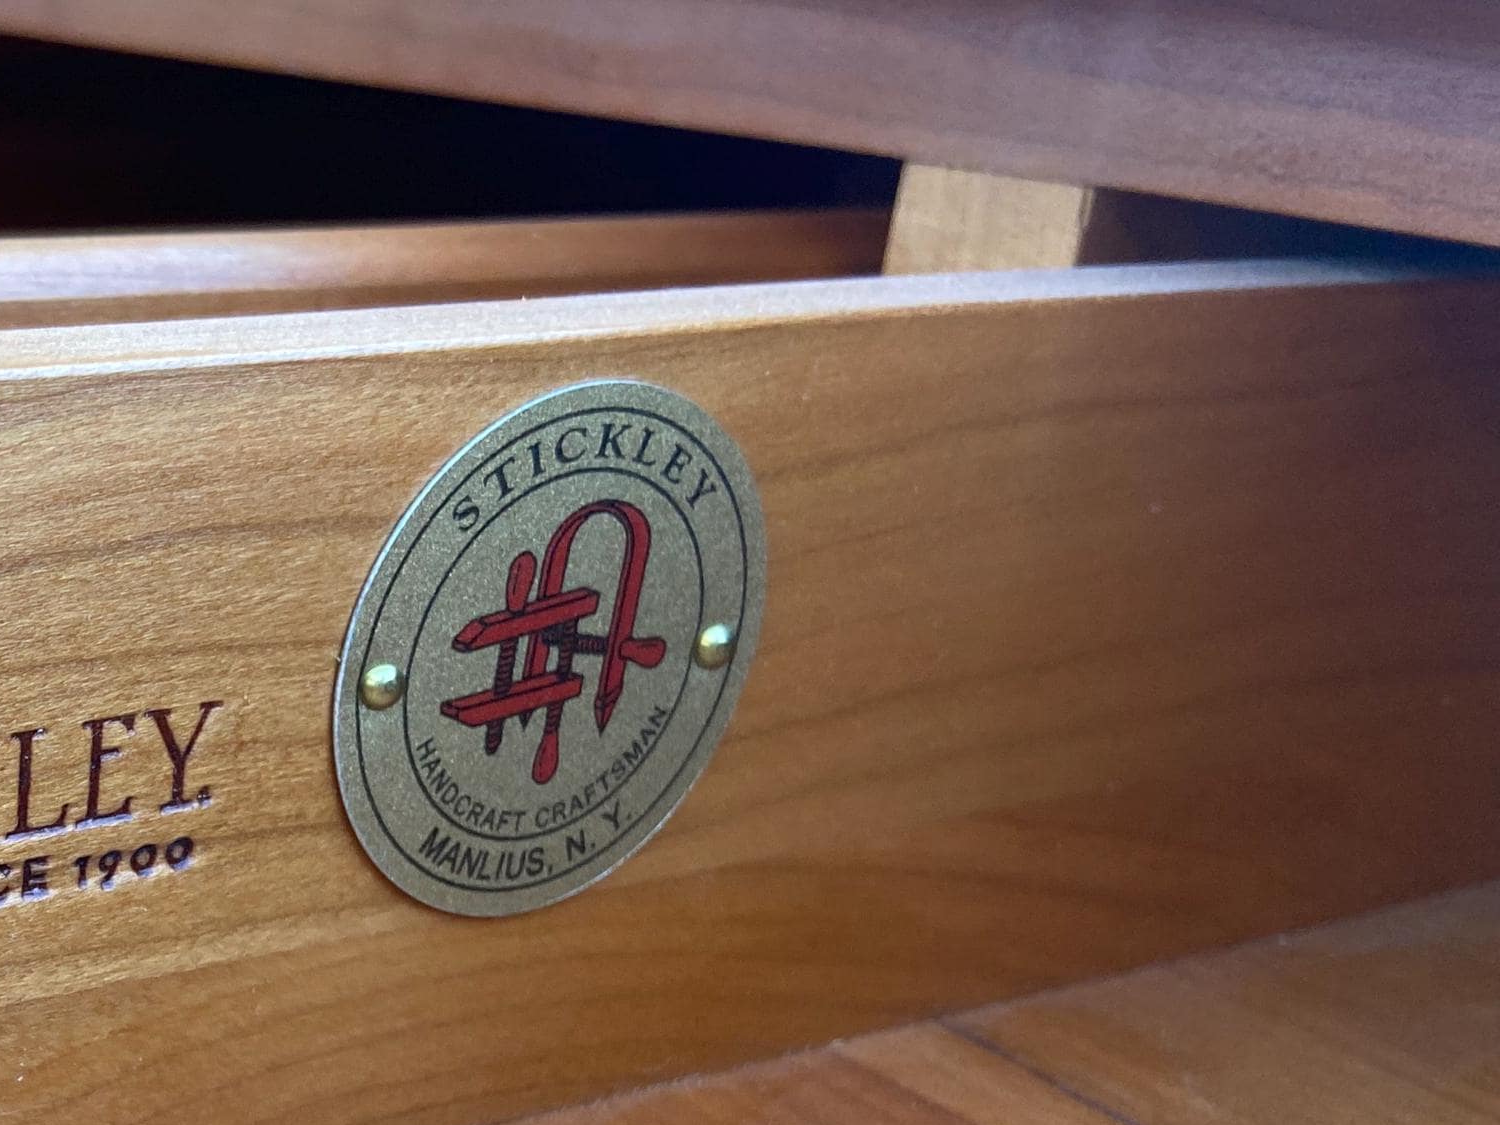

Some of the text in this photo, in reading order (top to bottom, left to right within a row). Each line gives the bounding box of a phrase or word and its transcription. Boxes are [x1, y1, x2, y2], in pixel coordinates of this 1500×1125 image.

[452, 422, 719, 533] STICKLEY
[416, 705, 668, 833] HANDCRAFT CRAFTSMAN
[75, 836, 195, 891] 1900
[419, 826, 554, 881] MANLIUS,
